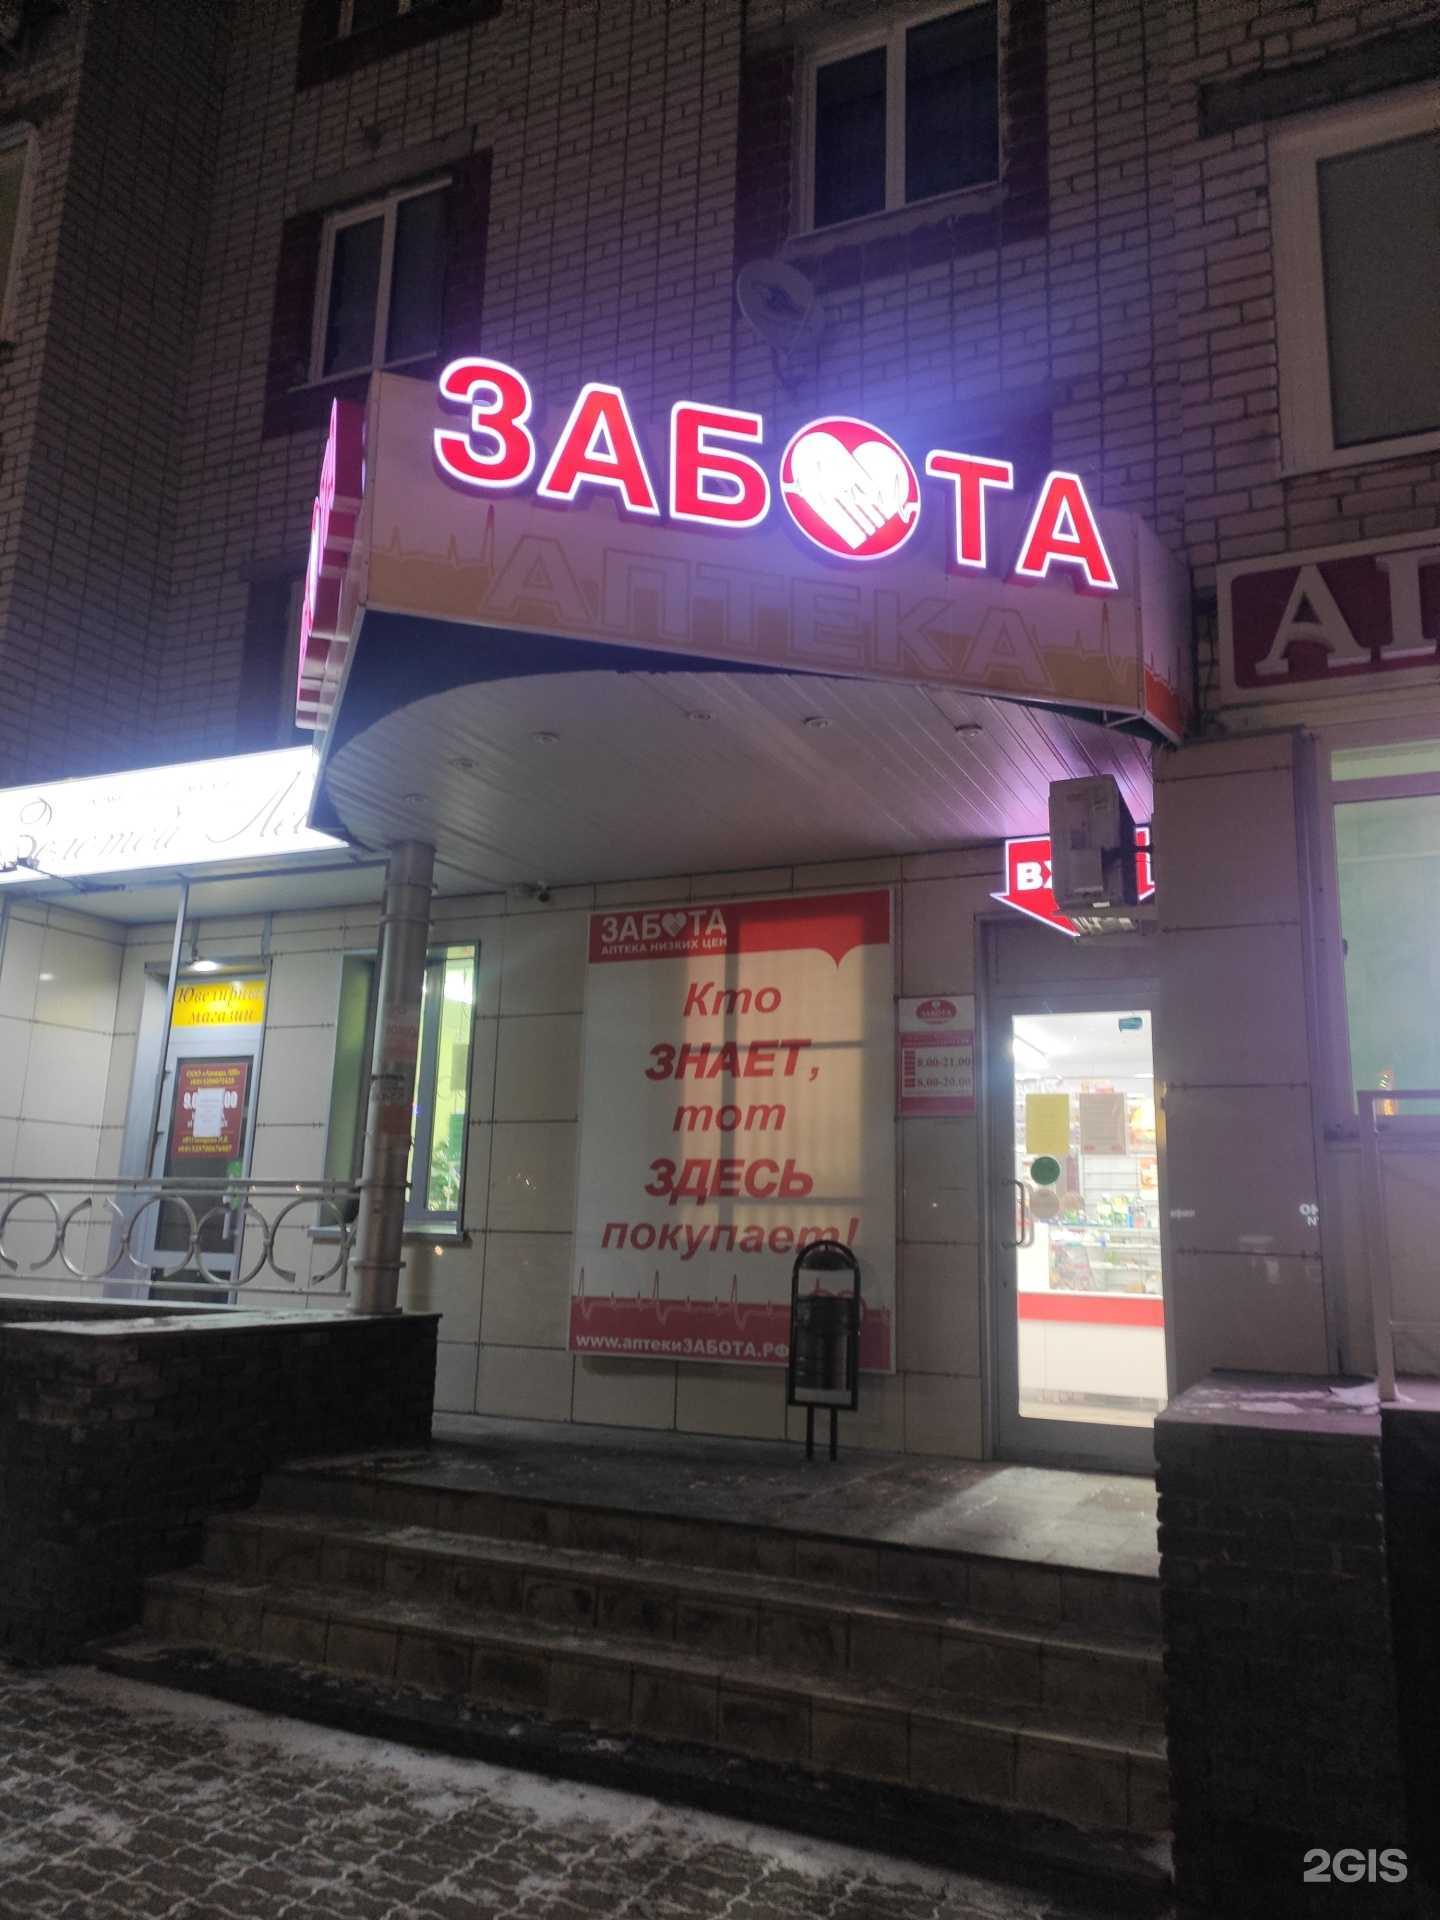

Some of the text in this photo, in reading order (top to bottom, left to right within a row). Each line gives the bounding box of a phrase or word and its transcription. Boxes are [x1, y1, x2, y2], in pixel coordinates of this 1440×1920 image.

[434, 357, 1119, 590] ЗАБОТА
[476, 534, 1054, 692] АПТЕКА
[601, 936, 727, 955] АПТЕКА НИЗКИХ ЦЕН
[683, 981, 782, 1017] Кто
[645, 1039, 819, 1081] ЗНАЕТ,
[672, 1103, 786, 1132] тот
[644, 1157, 814, 1206] ЗДЕСЬ
[601, 1217, 860, 1261] покупает!
